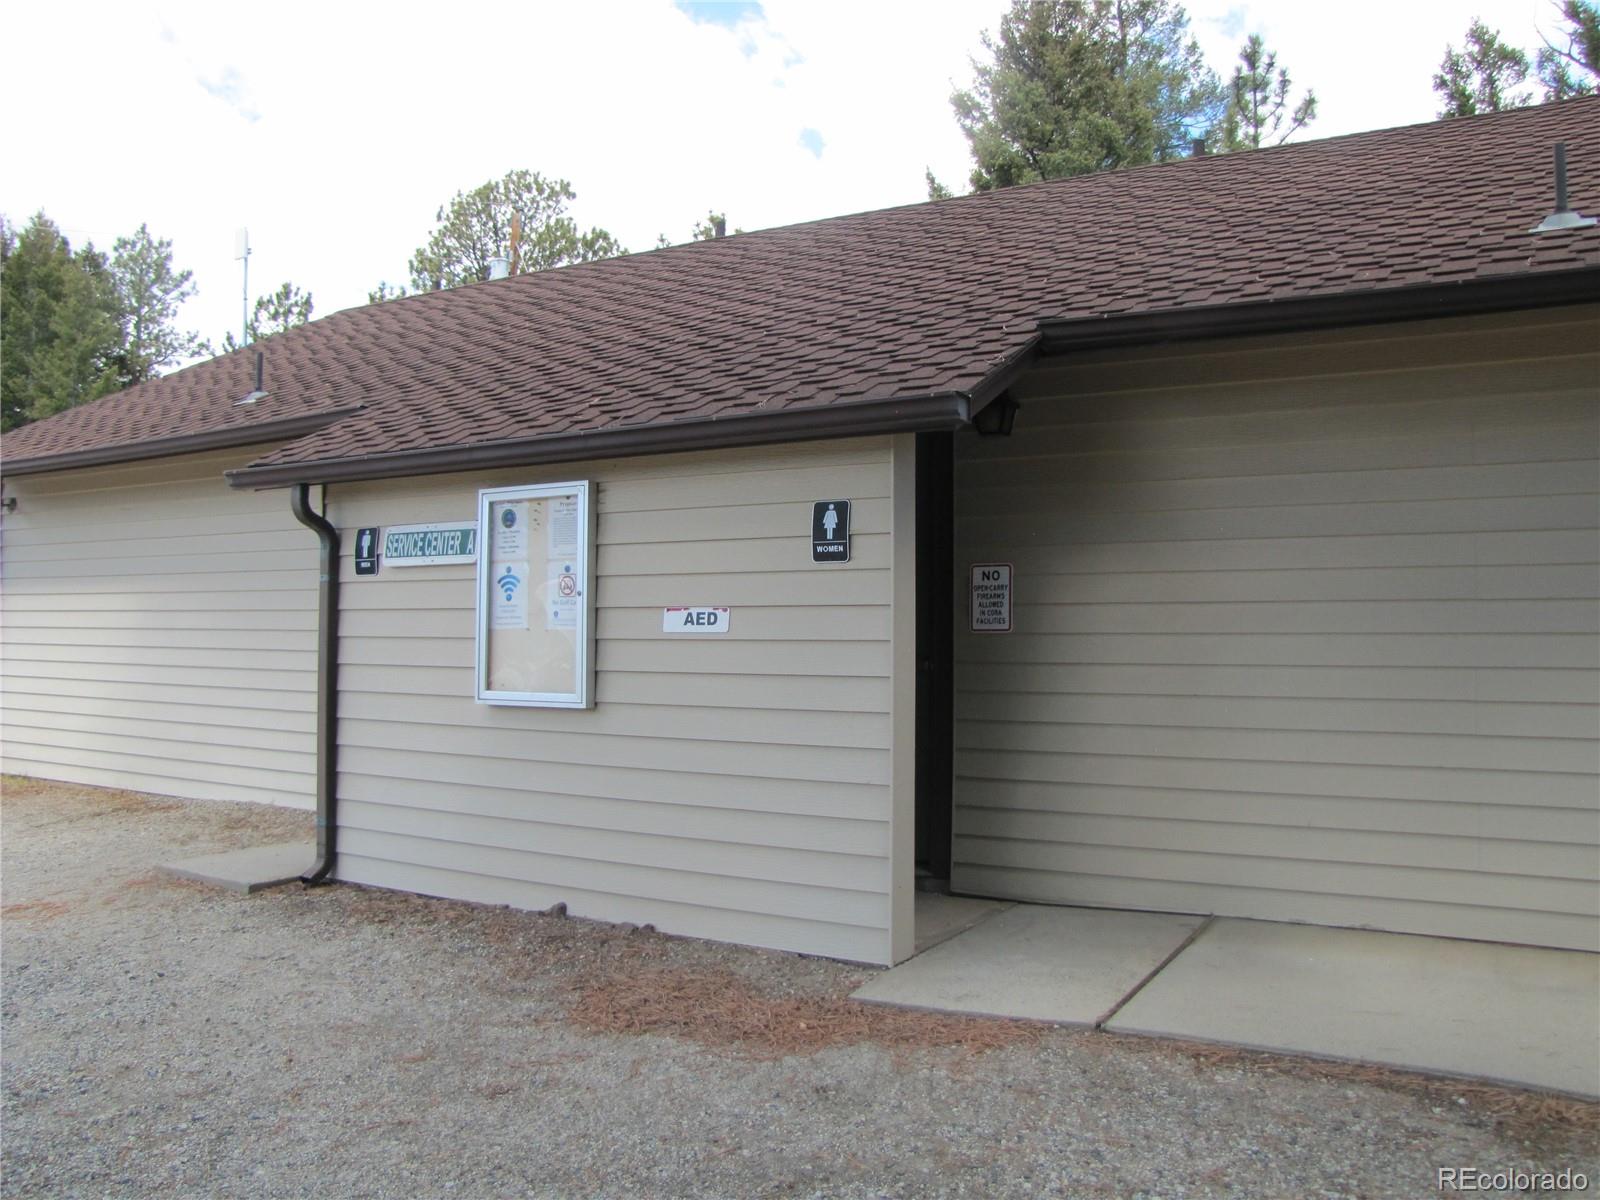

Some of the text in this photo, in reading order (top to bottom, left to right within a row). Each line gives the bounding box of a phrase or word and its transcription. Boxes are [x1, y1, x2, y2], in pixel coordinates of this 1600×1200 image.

[386, 533, 424, 557] SERVICE
[424, 531, 462, 556] CENTER
[816, 545, 844, 553] WOMEN
[981, 570, 1001, 581] NO
[976, 592, 1005, 600] FIREARMS
[683, 611, 719, 626] AED
[976, 616, 1006, 624] FACILITIES
